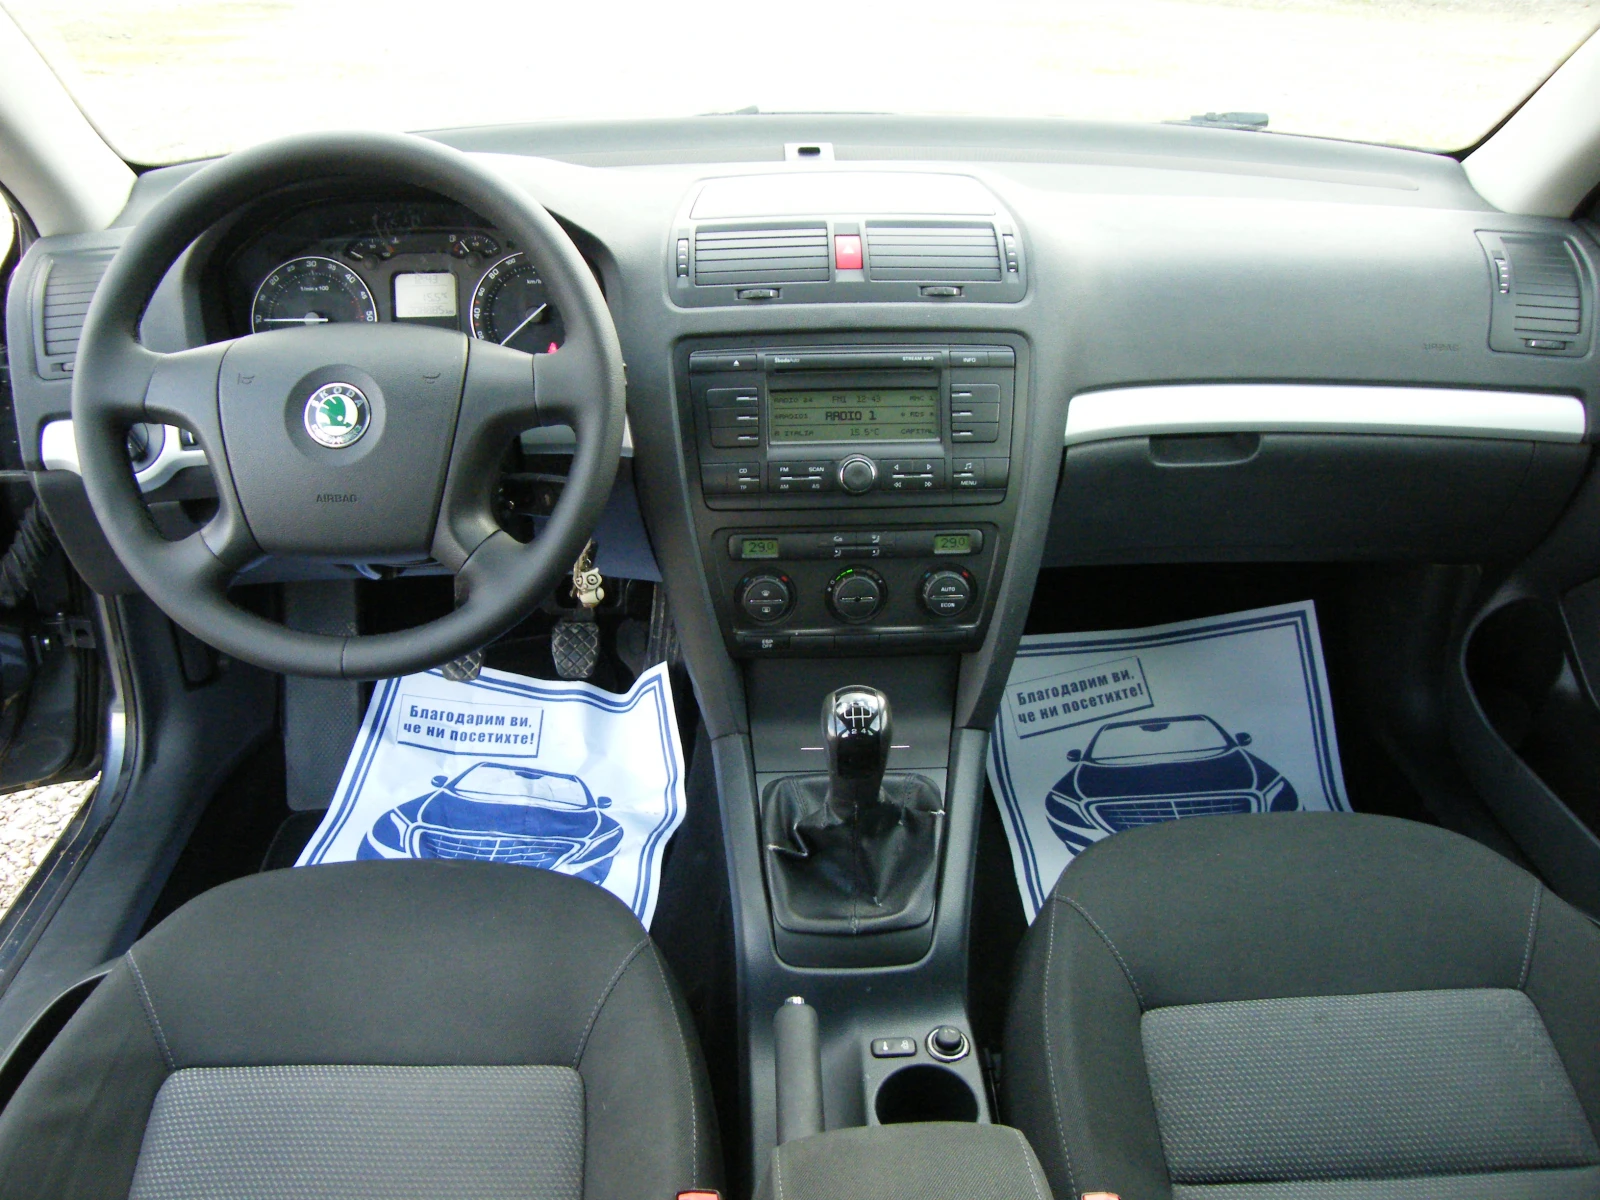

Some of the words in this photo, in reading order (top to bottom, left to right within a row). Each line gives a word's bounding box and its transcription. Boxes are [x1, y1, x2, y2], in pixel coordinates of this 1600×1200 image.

[306, 260, 317, 268] 30
[327, 262, 337, 271] 35
[505, 257, 517, 267] 100
[268, 274, 280, 286] 20
[344, 273, 356, 284] 40
[488, 268, 500, 280] 80
[477, 286, 486, 298] 60
[366, 310, 374, 322] 50
[473, 307, 481, 320] 40
[825, 411, 862, 421] RADIO
[868, 410, 877, 420] 1
[315, 494, 358, 503] AIRBAG
[1016, 674, 1108, 706] Благодарим
[1018, 711, 1036, 724] че
[1039, 705, 1059, 720] ни
[1061, 682, 1144, 715] посетихте!
[409, 704, 505, 727] Благодарим
[403, 722, 421, 734] че
[426, 725, 445, 739] ни
[449, 730, 535, 745] посетихте!
